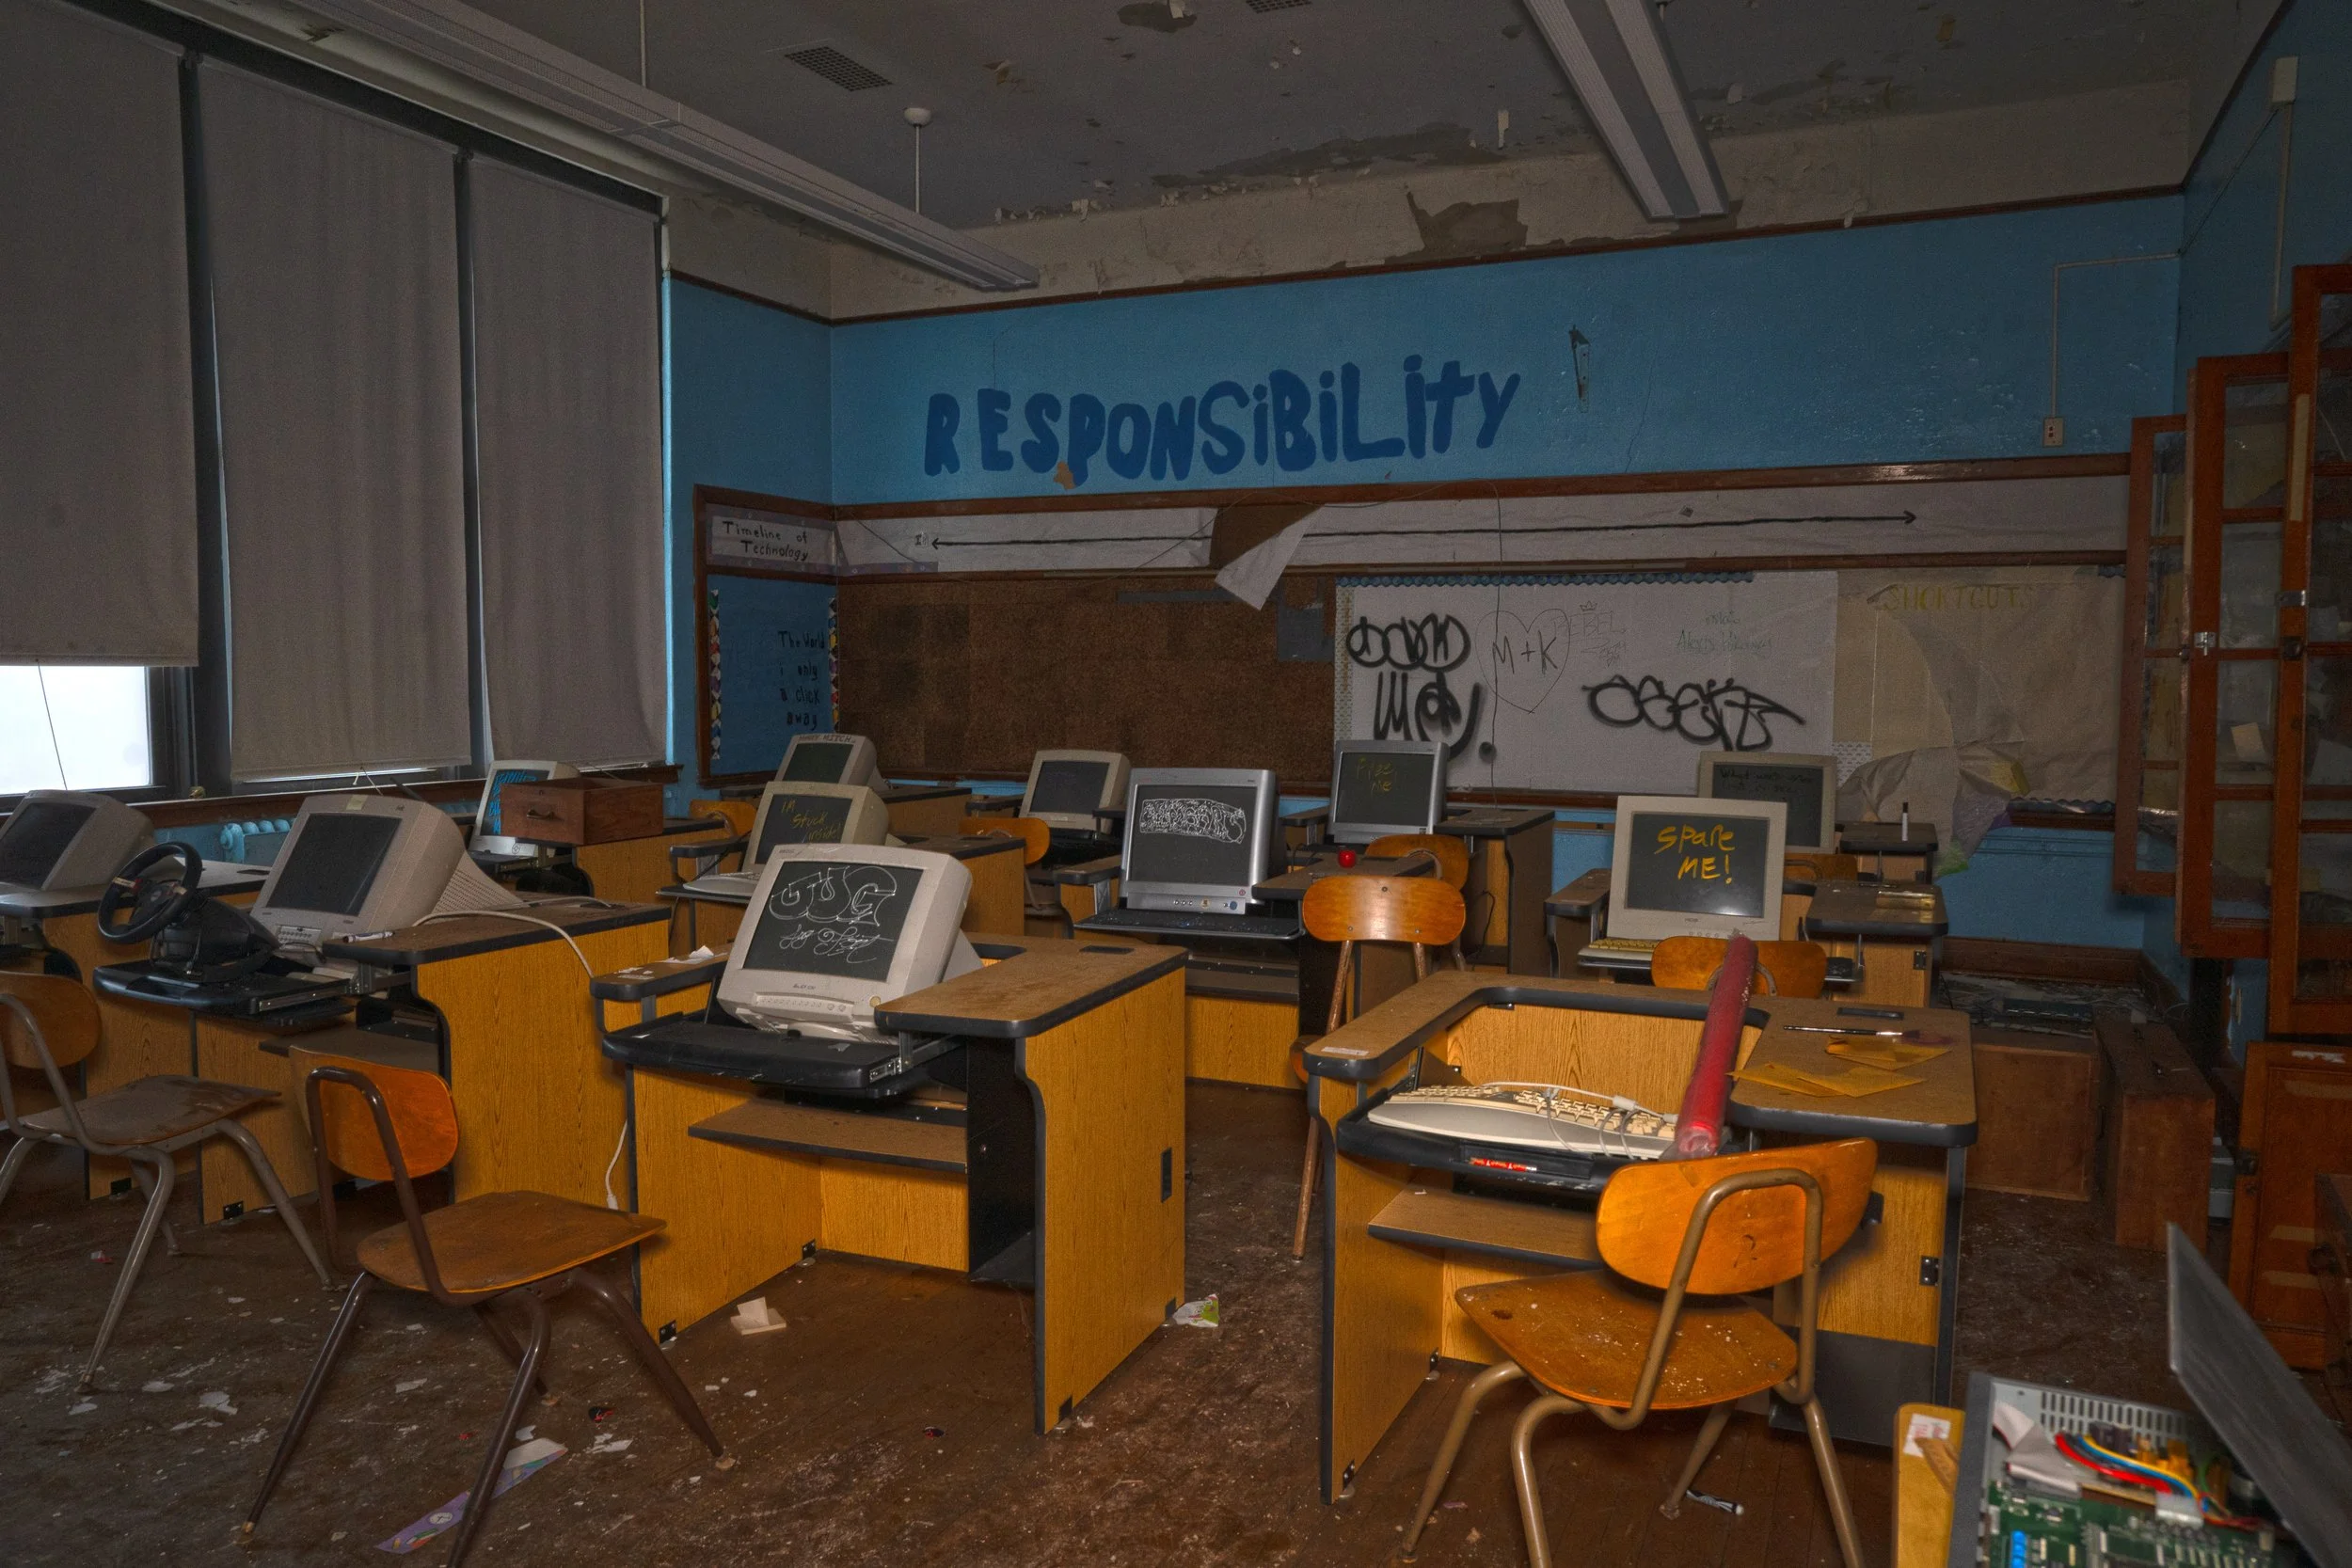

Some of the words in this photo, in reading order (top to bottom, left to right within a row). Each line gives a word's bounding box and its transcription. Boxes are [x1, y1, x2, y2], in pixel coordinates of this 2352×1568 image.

[722, 520, 781, 541] Timeline
[796, 531, 808, 544] of
[740, 540, 809, 562] Technology
[777, 630, 801, 648] The
[797, 660, 818, 681] only
[795, 686, 821, 705] click
[787, 711, 818, 732] away
[1677, 854, 1734, 885] ME!
